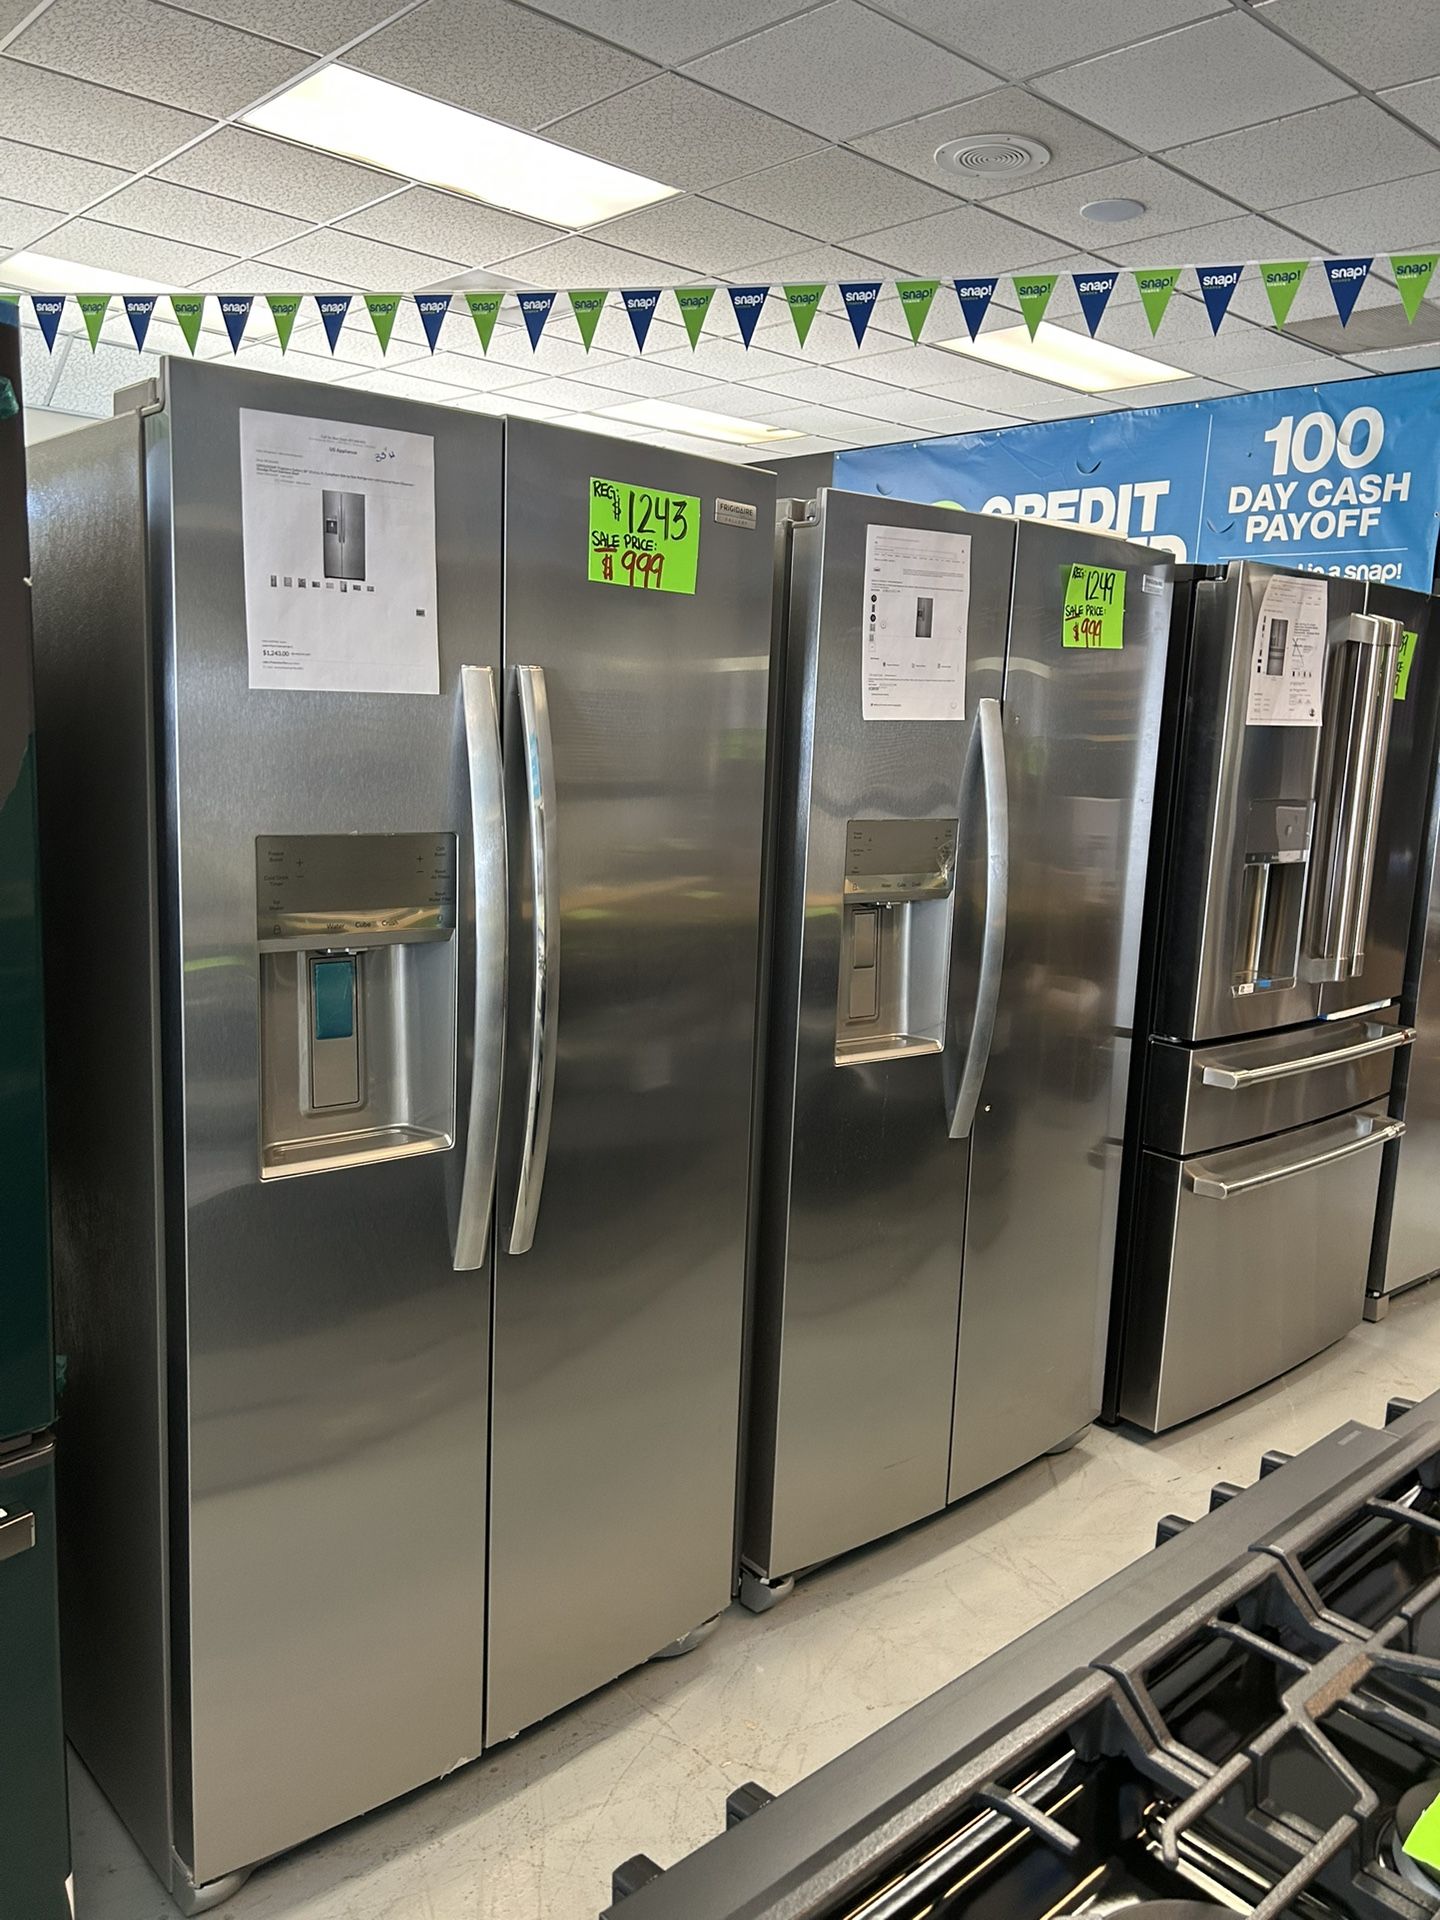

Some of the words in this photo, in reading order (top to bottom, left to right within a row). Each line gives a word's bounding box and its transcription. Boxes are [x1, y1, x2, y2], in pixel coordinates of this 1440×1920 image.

[1330, 265, 1366, 280] snap!
[1396, 262, 1431, 275] snap!
[1140, 276, 1173, 290] snap!
[1203, 272, 1237, 287] snap!
[1266, 270, 1300, 283] snap!
[960, 285, 993, 298] snap!
[1019, 283, 1051, 296] snap!
[1079, 279, 1112, 293] snap!
[734, 293, 764, 306] snap!
[790, 292, 819, 305] snap!
[845, 289, 876, 303] snap!
[902, 287, 933, 301] snap!
[36, 302, 62, 314] snap!
[127, 302, 153, 314] snap!
[222, 302, 250, 314] snap!
[321, 302, 347, 314] snap!
[420, 301, 447, 313] snap!
[522, 299, 550, 311] snap!
[627, 296, 656, 309] snap!
[1264, 406, 1385, 476] 100
[1228, 481, 1299, 514] DAY
[1308, 472, 1412, 508] CASH
[720, 503, 754, 517] FRIGIDAIRE
[1245, 506, 1382, 543] PAYOFF
[592, 530, 620, 548] SALE
[623, 535, 658, 551] PRICE:
[1343, 562, 1402, 584] snap!
[1085, 570, 1116, 605] 1249
[1065, 604, 1083, 617] SALE
